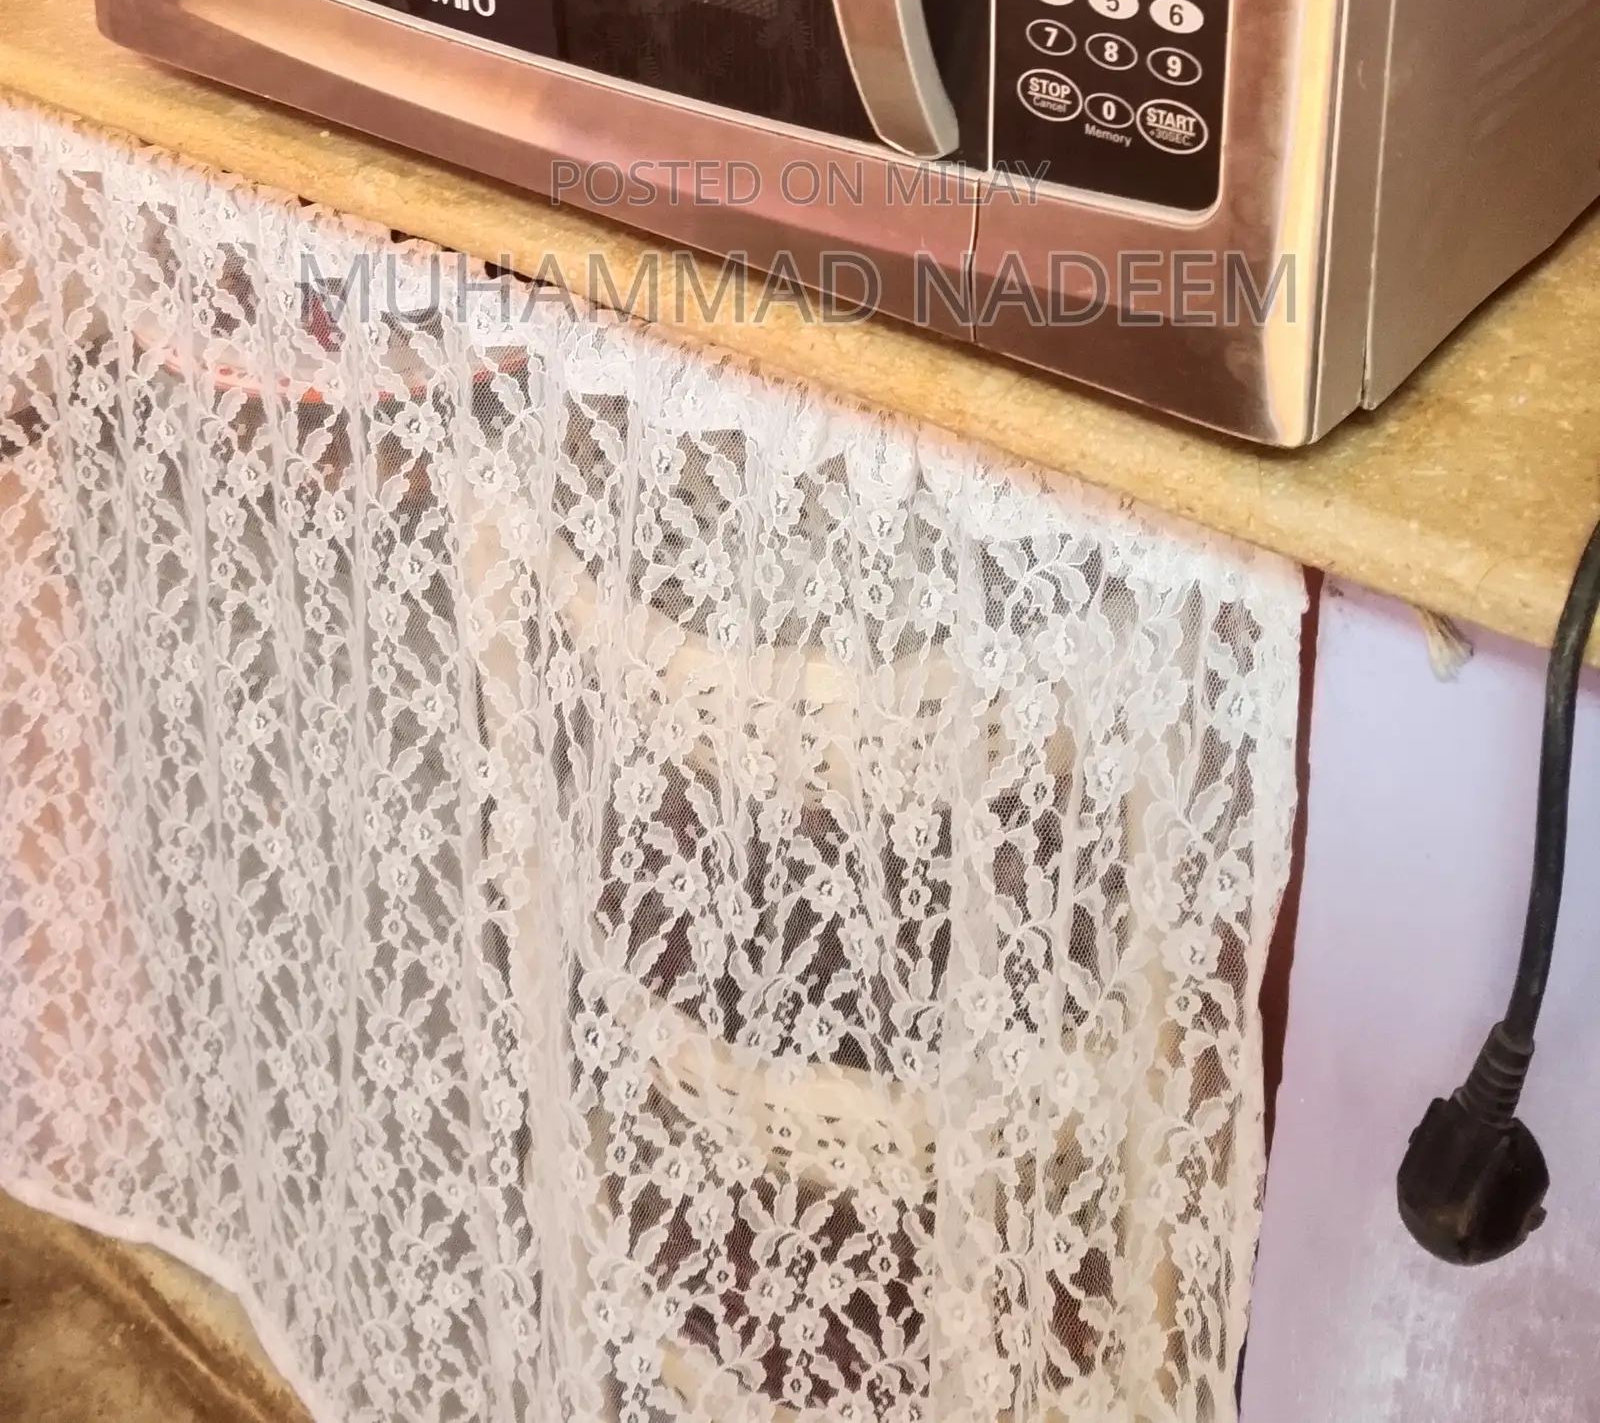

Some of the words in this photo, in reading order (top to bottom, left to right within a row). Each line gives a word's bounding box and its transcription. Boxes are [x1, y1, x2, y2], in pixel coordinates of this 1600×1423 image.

[1169, 3, 1184, 27] 6
[1044, 27, 1058, 47] 7
[1104, 41, 1119, 62] 8
[1166, 55, 1182, 77] 9
[1029, 77, 1071, 99] STOP
[1033, 96, 1067, 113] Cancel
[1102, 101, 1116, 120] 0
[1146, 107, 1197, 132] START
[1085, 123, 1132, 147] Memory
